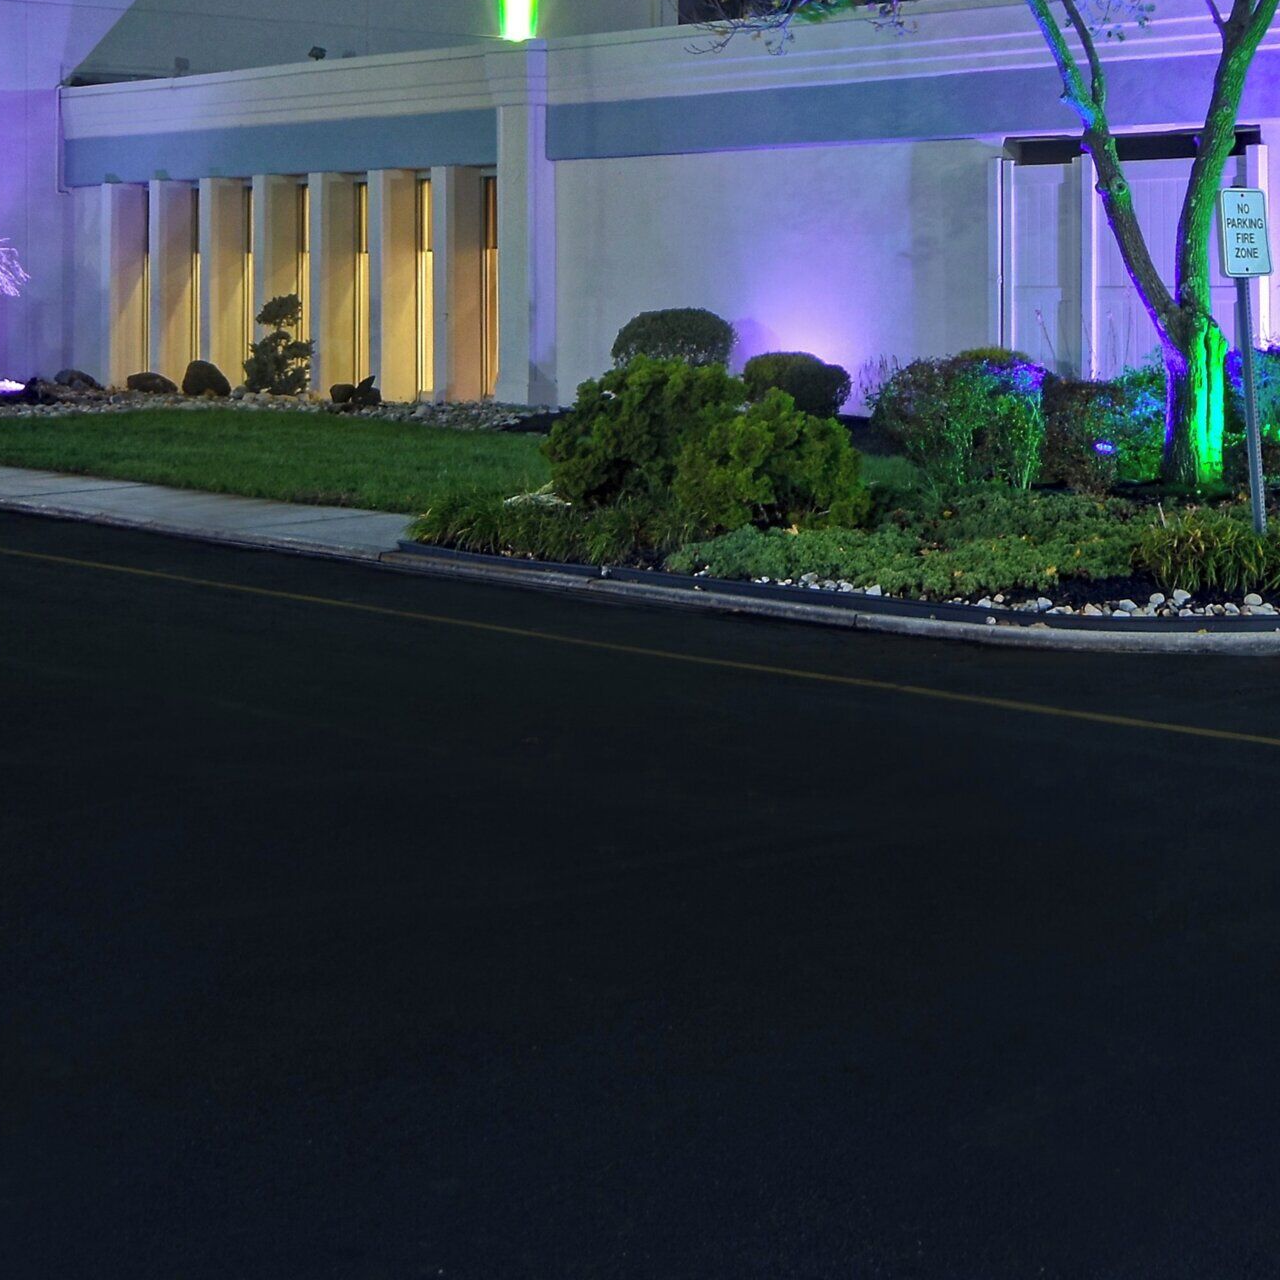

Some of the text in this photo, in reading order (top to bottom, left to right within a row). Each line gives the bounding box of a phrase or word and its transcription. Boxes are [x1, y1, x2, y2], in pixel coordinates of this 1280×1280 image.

[1236, 203, 1250, 215] NO
[1226, 217, 1264, 229] PARKING
[1235, 232, 1256, 244] FIRE
[1234, 247, 1260, 259] ZONE
